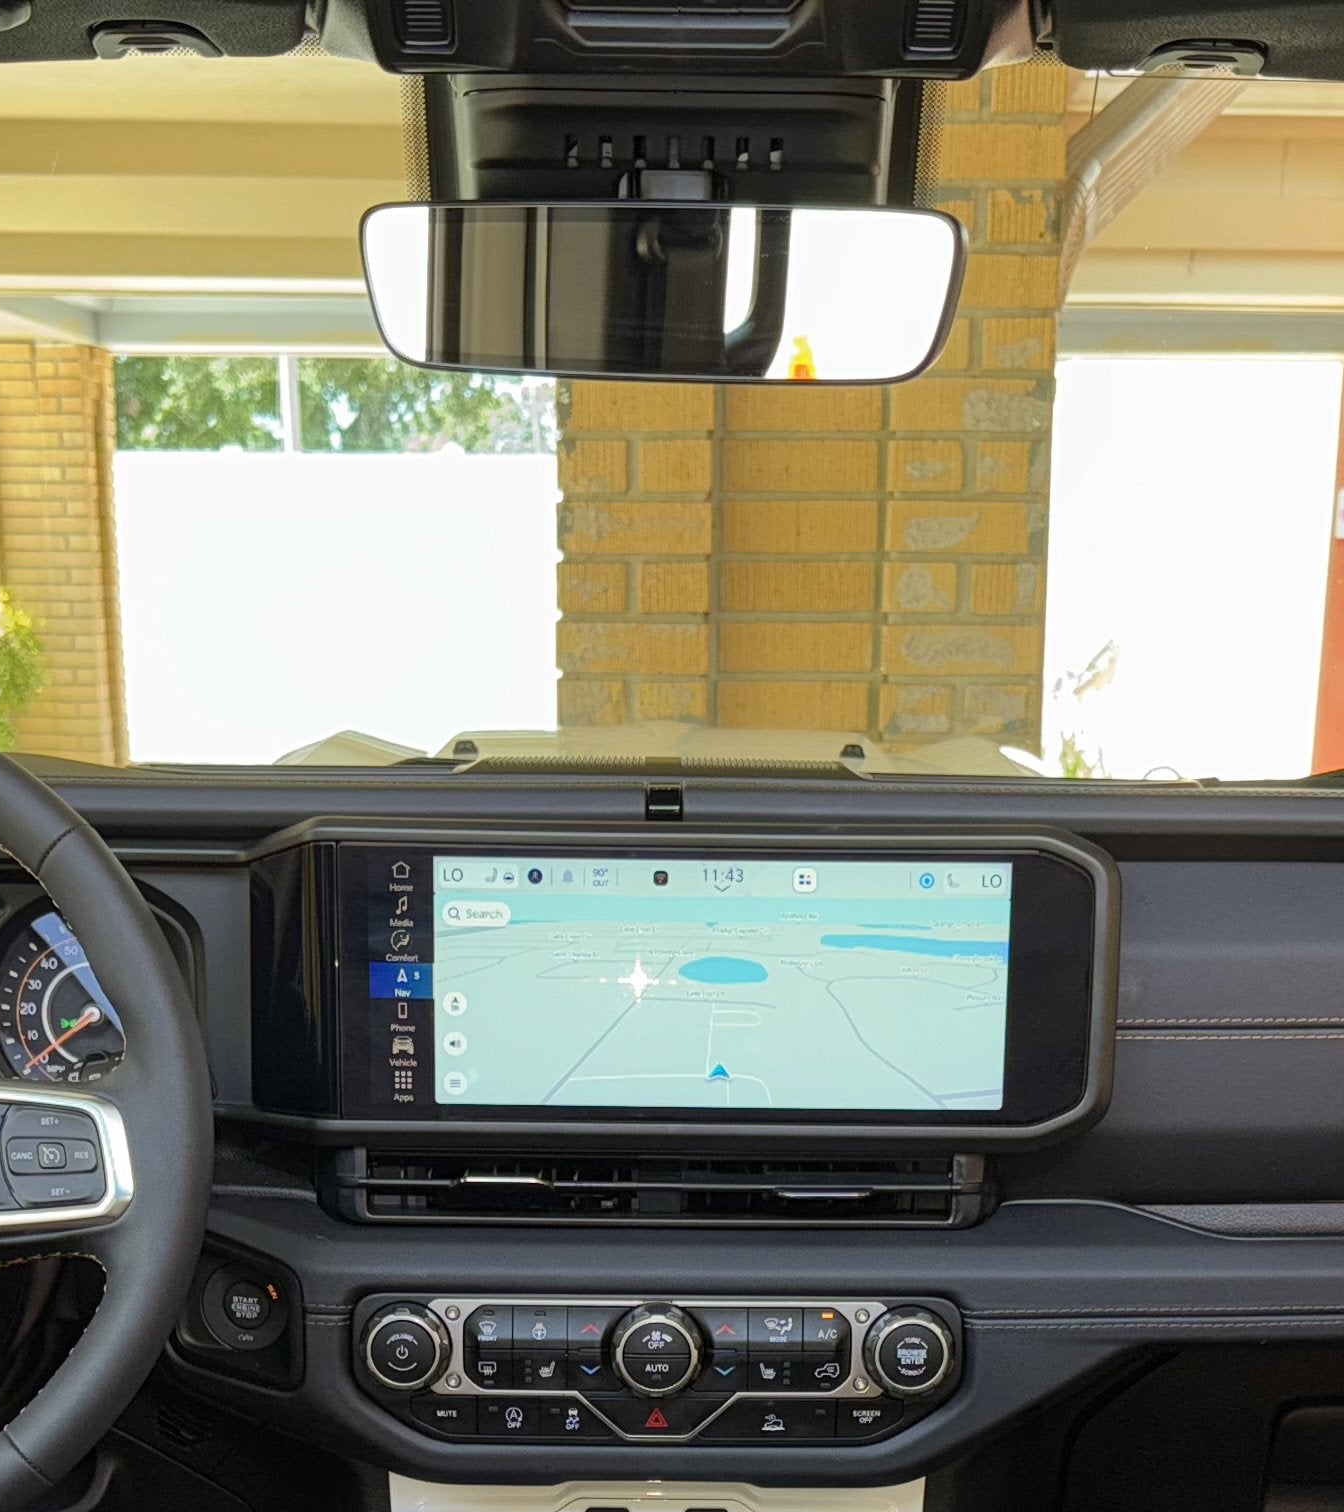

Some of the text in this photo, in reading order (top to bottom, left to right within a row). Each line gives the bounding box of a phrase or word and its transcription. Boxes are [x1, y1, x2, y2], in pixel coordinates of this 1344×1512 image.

[443, 868, 464, 882] LO
[702, 868, 744, 883] 11:43
[982, 874, 1002, 888] LO
[389, 883, 414, 892] Home
[466, 908, 503, 919] Search
[389, 918, 414, 928] Media
[385, 953, 419, 963] Comfort
[40, 957, 58, 970] 40
[28, 979, 43, 991] 30
[395, 988, 411, 998] Nav
[20, 1002, 37, 1016] 20
[390, 1023, 416, 1033] Phone
[389, 1058, 418, 1068] Vehicle
[393, 1093, 414, 1103] Apps
[10, 1151, 33, 1161] CANC
[232, 1295, 259, 1304] START
[235, 1311, 258, 1319] STOP
[817, 1328, 838, 1340] A/C
[647, 1341, 665, 1350] OFF
[900, 1357, 925, 1365] ENTER
[645, 1363, 669, 1374] AUTO
[436, 1409, 458, 1418] MUTE
[852, 1409, 881, 1417] SCREEN
[506, 1421, 522, 1429] OFF
[858, 1416, 873, 1424] OFF
